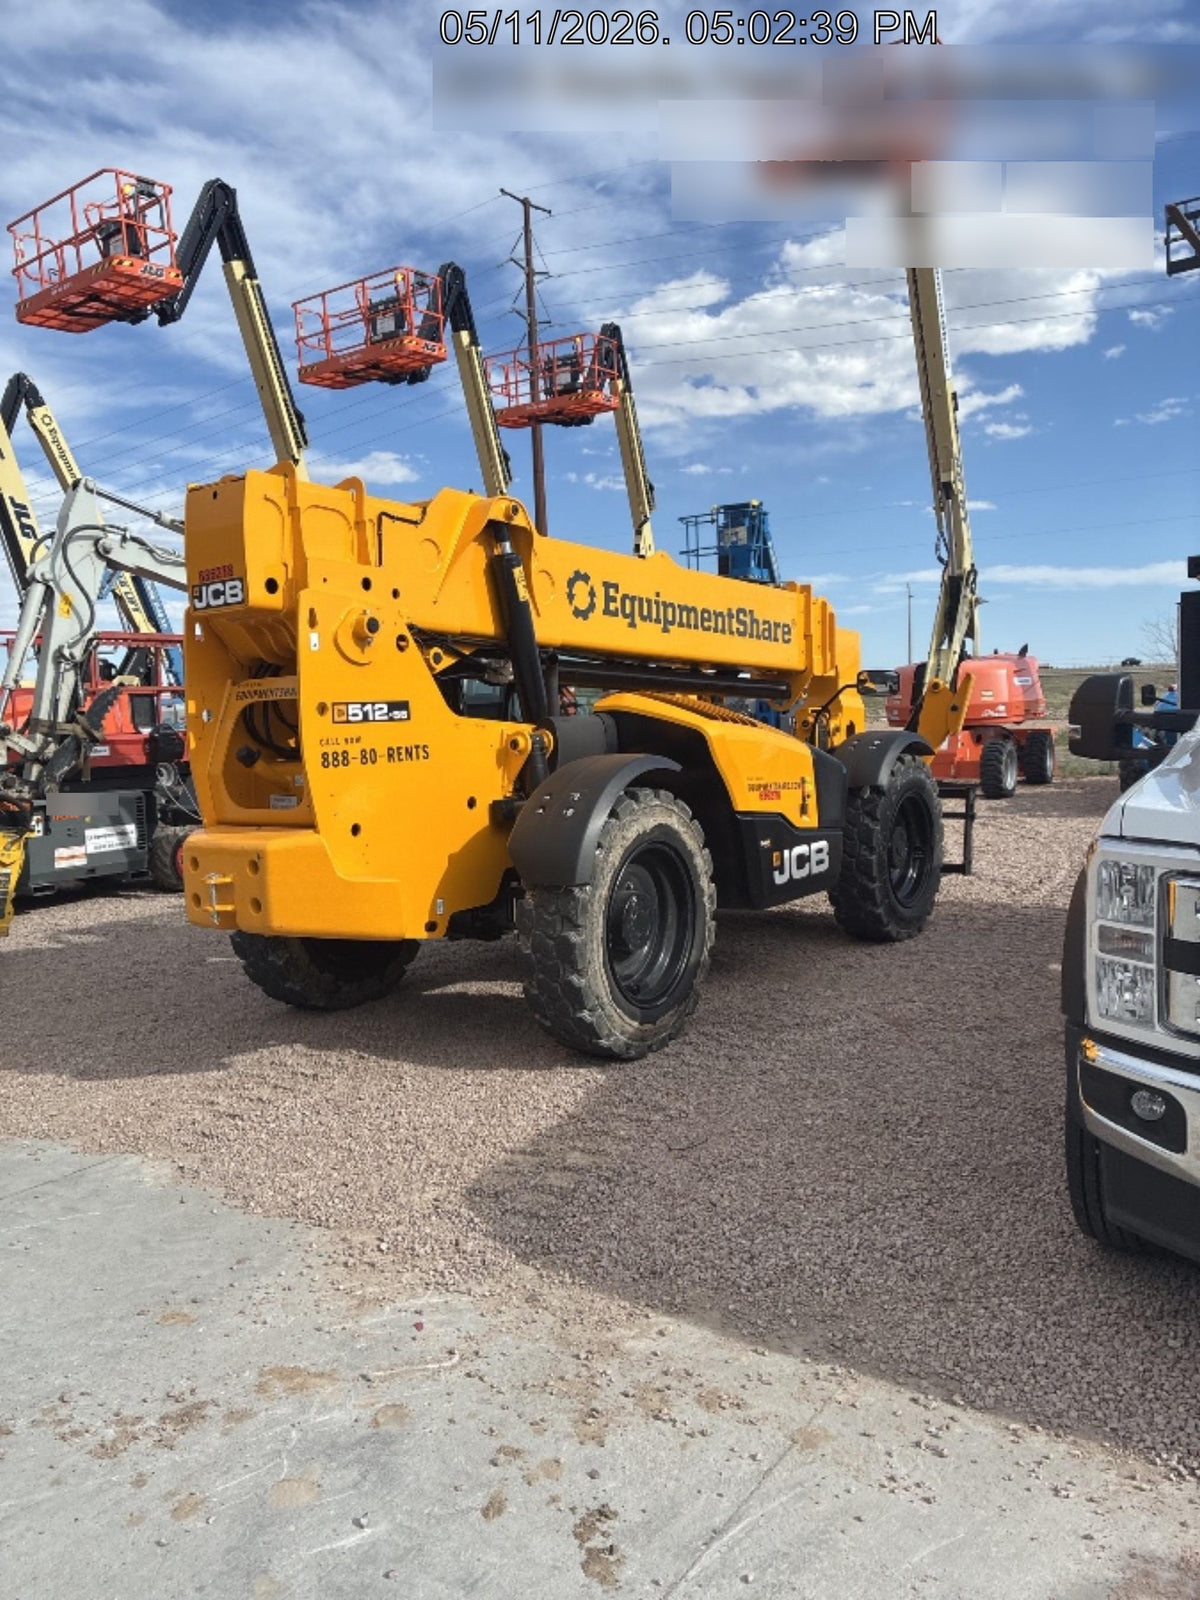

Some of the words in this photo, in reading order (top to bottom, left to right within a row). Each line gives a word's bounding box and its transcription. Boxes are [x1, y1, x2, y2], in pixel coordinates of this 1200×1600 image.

[8, 495, 38, 540] JLG
[193, 580, 243, 609] JCB
[602, 580, 793, 645] EquipmentShare
[320, 744, 430, 769] 888-80-RENTS
[772, 840, 830, 885] JCB
